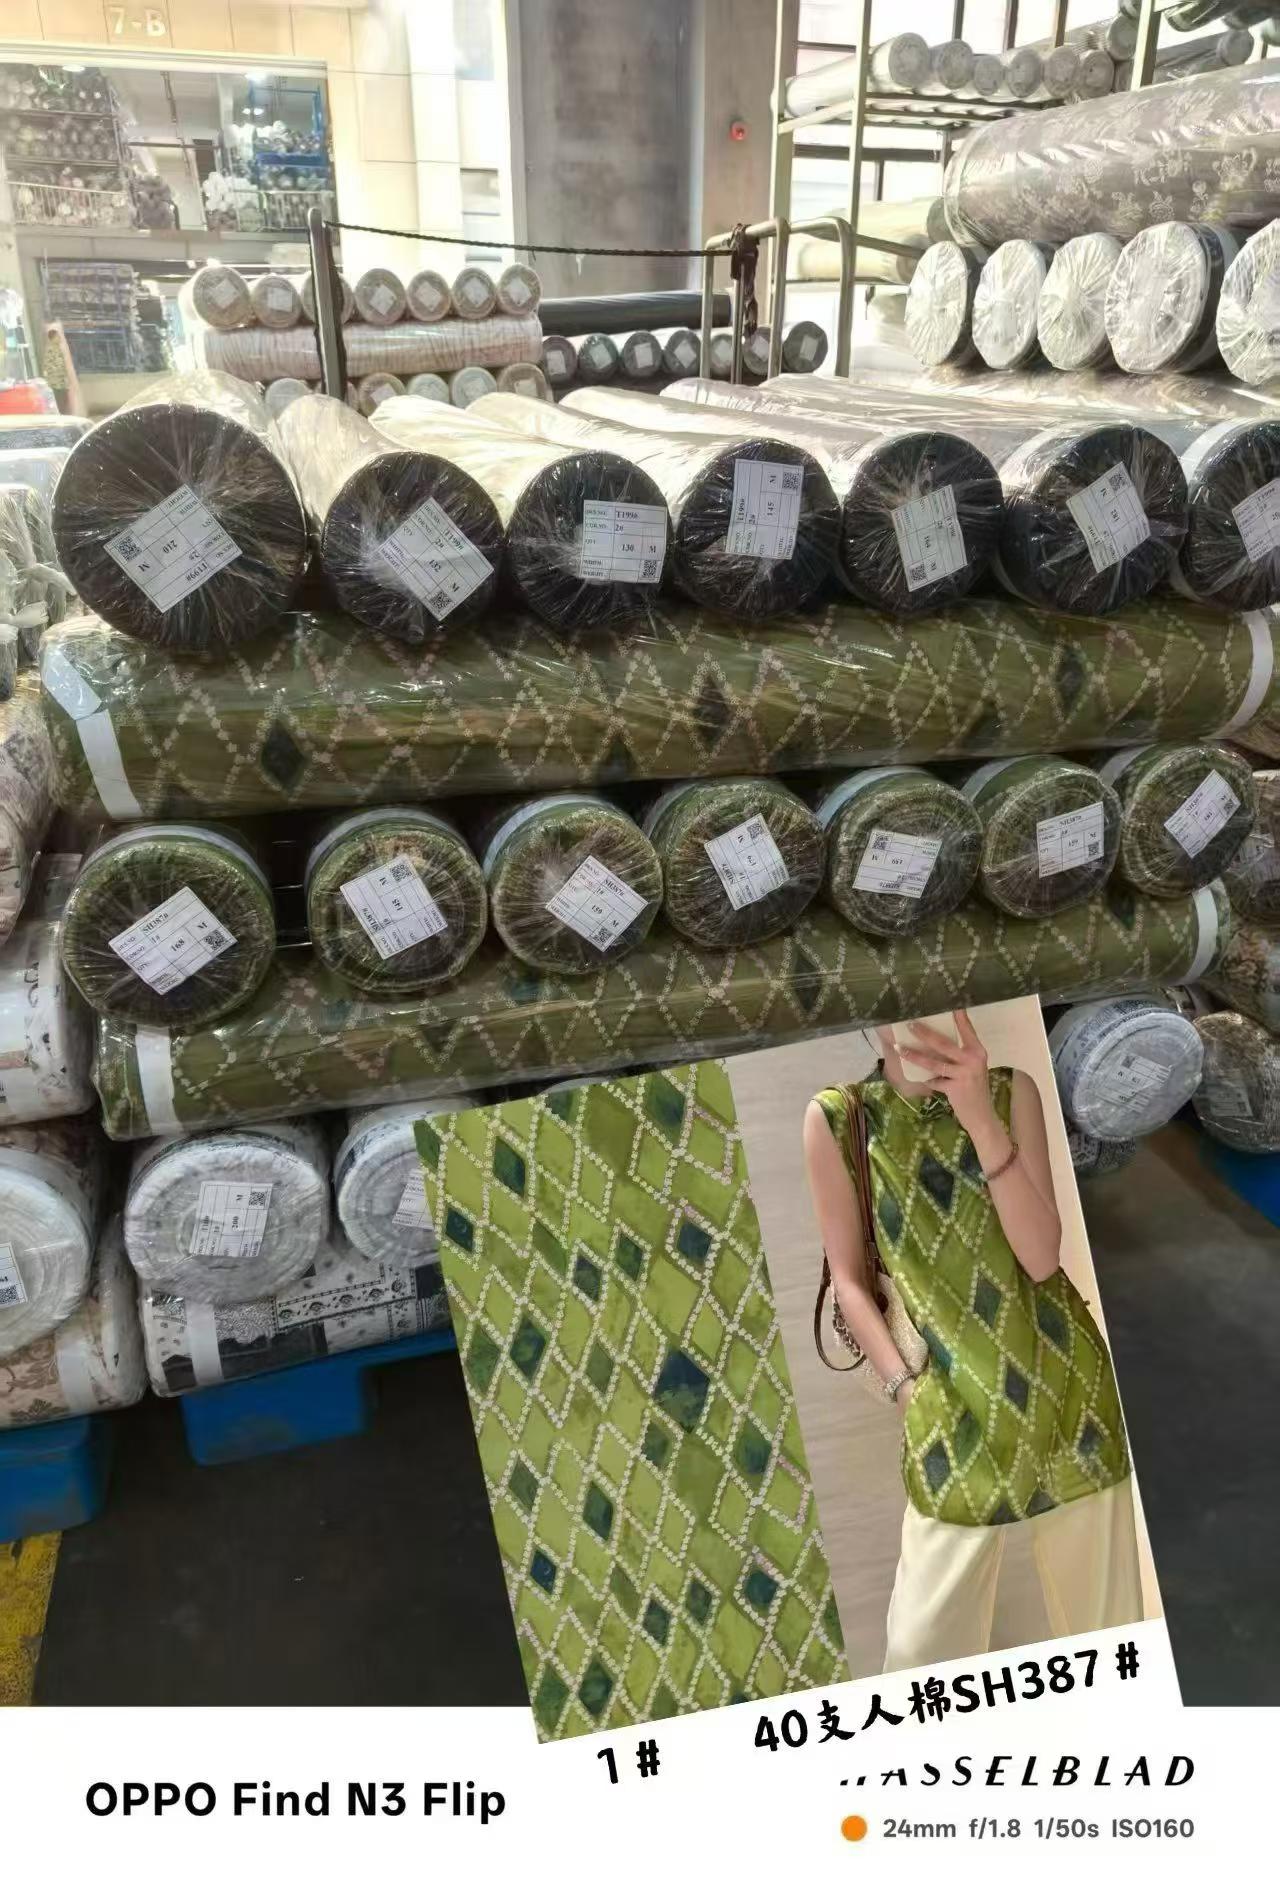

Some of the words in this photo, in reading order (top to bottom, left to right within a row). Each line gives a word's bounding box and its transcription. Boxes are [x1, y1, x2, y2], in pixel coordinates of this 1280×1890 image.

[109, 6, 166, 36] 7-B
[769, 474, 776, 483] M
[766, 501, 774, 516] 145
[161, 539, 177, 554] 210
[137, 560, 150, 572] M
[184, 562, 208, 582] T199#
[449, 581, 459, 592] M
[737, 834, 744, 843] M
[378, 876, 387, 885] M
[141, 911, 169, 933] SH387#
[196, 921, 207, 931] M
[610, 919, 619, 927] M
[231, 1216, 240, 1228] 200
